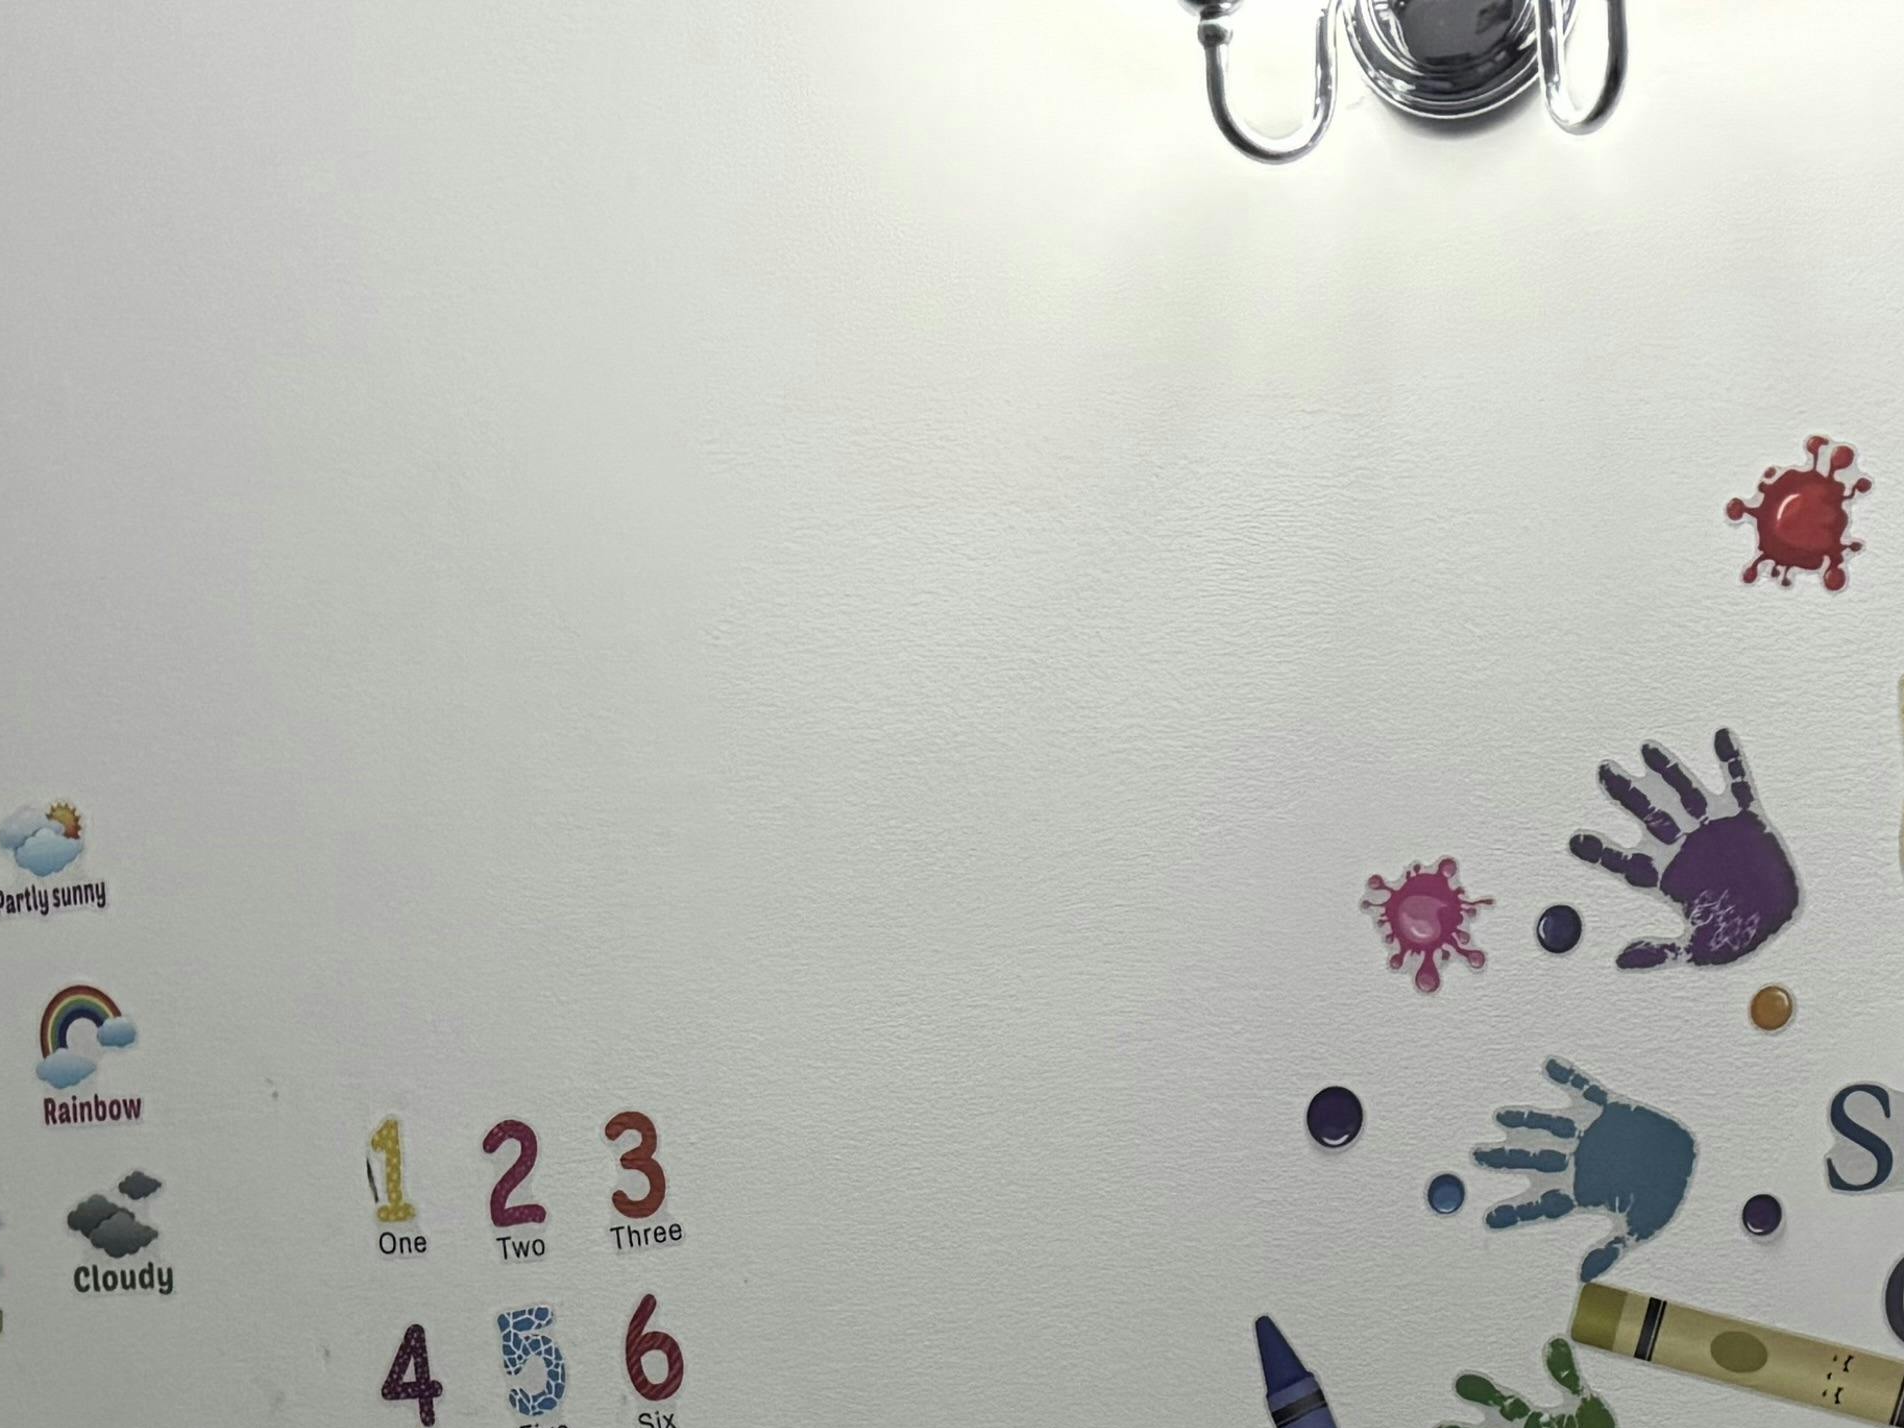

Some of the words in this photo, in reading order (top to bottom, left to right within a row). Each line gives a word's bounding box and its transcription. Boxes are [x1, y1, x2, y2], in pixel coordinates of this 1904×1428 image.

[52, 879, 107, 909] sunny
[43, 1095, 142, 1125] Rainbow
[371, 1119, 416, 1223] 1
[482, 1119, 546, 1228] 2
[605, 1111, 666, 1219] 3
[378, 1231, 427, 1255] One
[496, 1236, 546, 1260] Two
[610, 1222, 683, 1250] Three
[73, 1261, 174, 1296] Cloudy
[381, 1323, 443, 1427] 4
[496, 1304, 566, 1417] 5
[625, 1294, 684, 1401] 6
